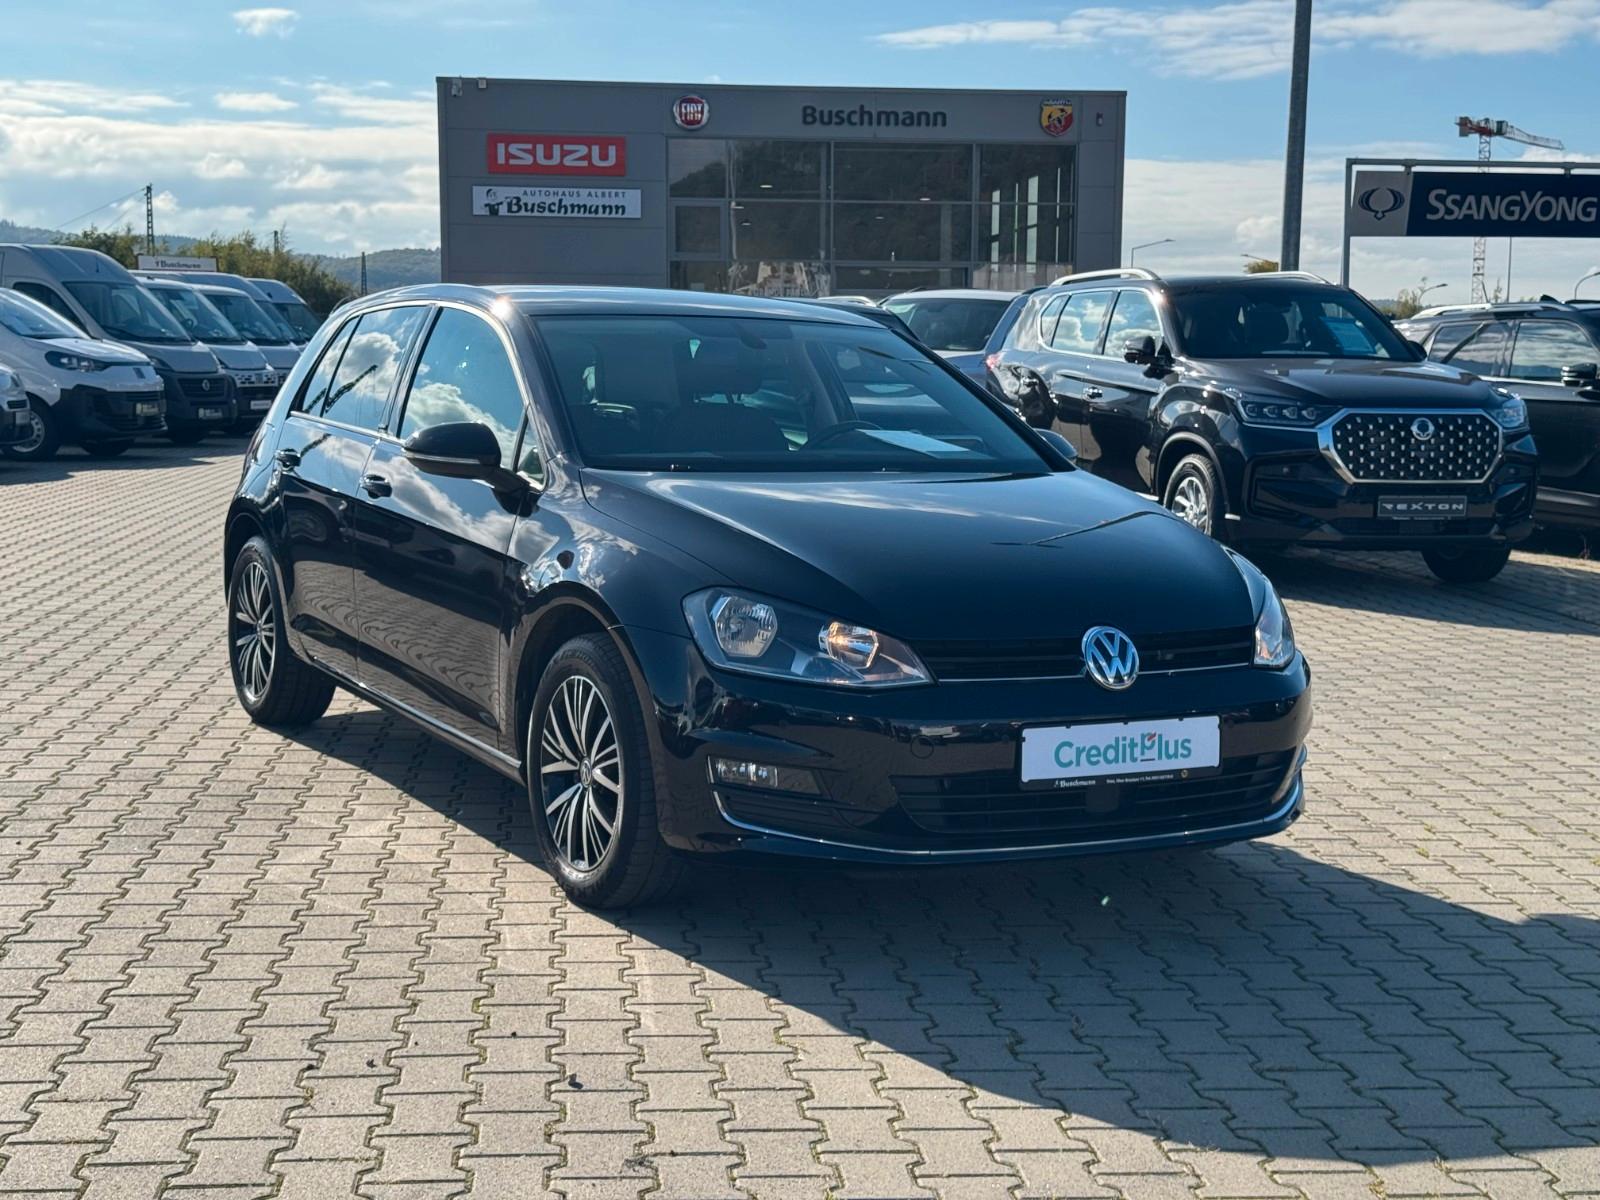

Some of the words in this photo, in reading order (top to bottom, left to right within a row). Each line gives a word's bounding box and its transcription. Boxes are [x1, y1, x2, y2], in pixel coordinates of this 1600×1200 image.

[681, 103, 703, 121] FIAT
[802, 104, 947, 128] Buschmann
[497, 142, 617, 167] ISUZU
[522, 189, 581, 198] AUTOHAUS
[588, 190, 627, 199] ALBERT
[504, 195, 627, 217] Buschmann
[1381, 502, 1464, 511] REXTON
[1053, 731, 1193, 769] CreditPlus
